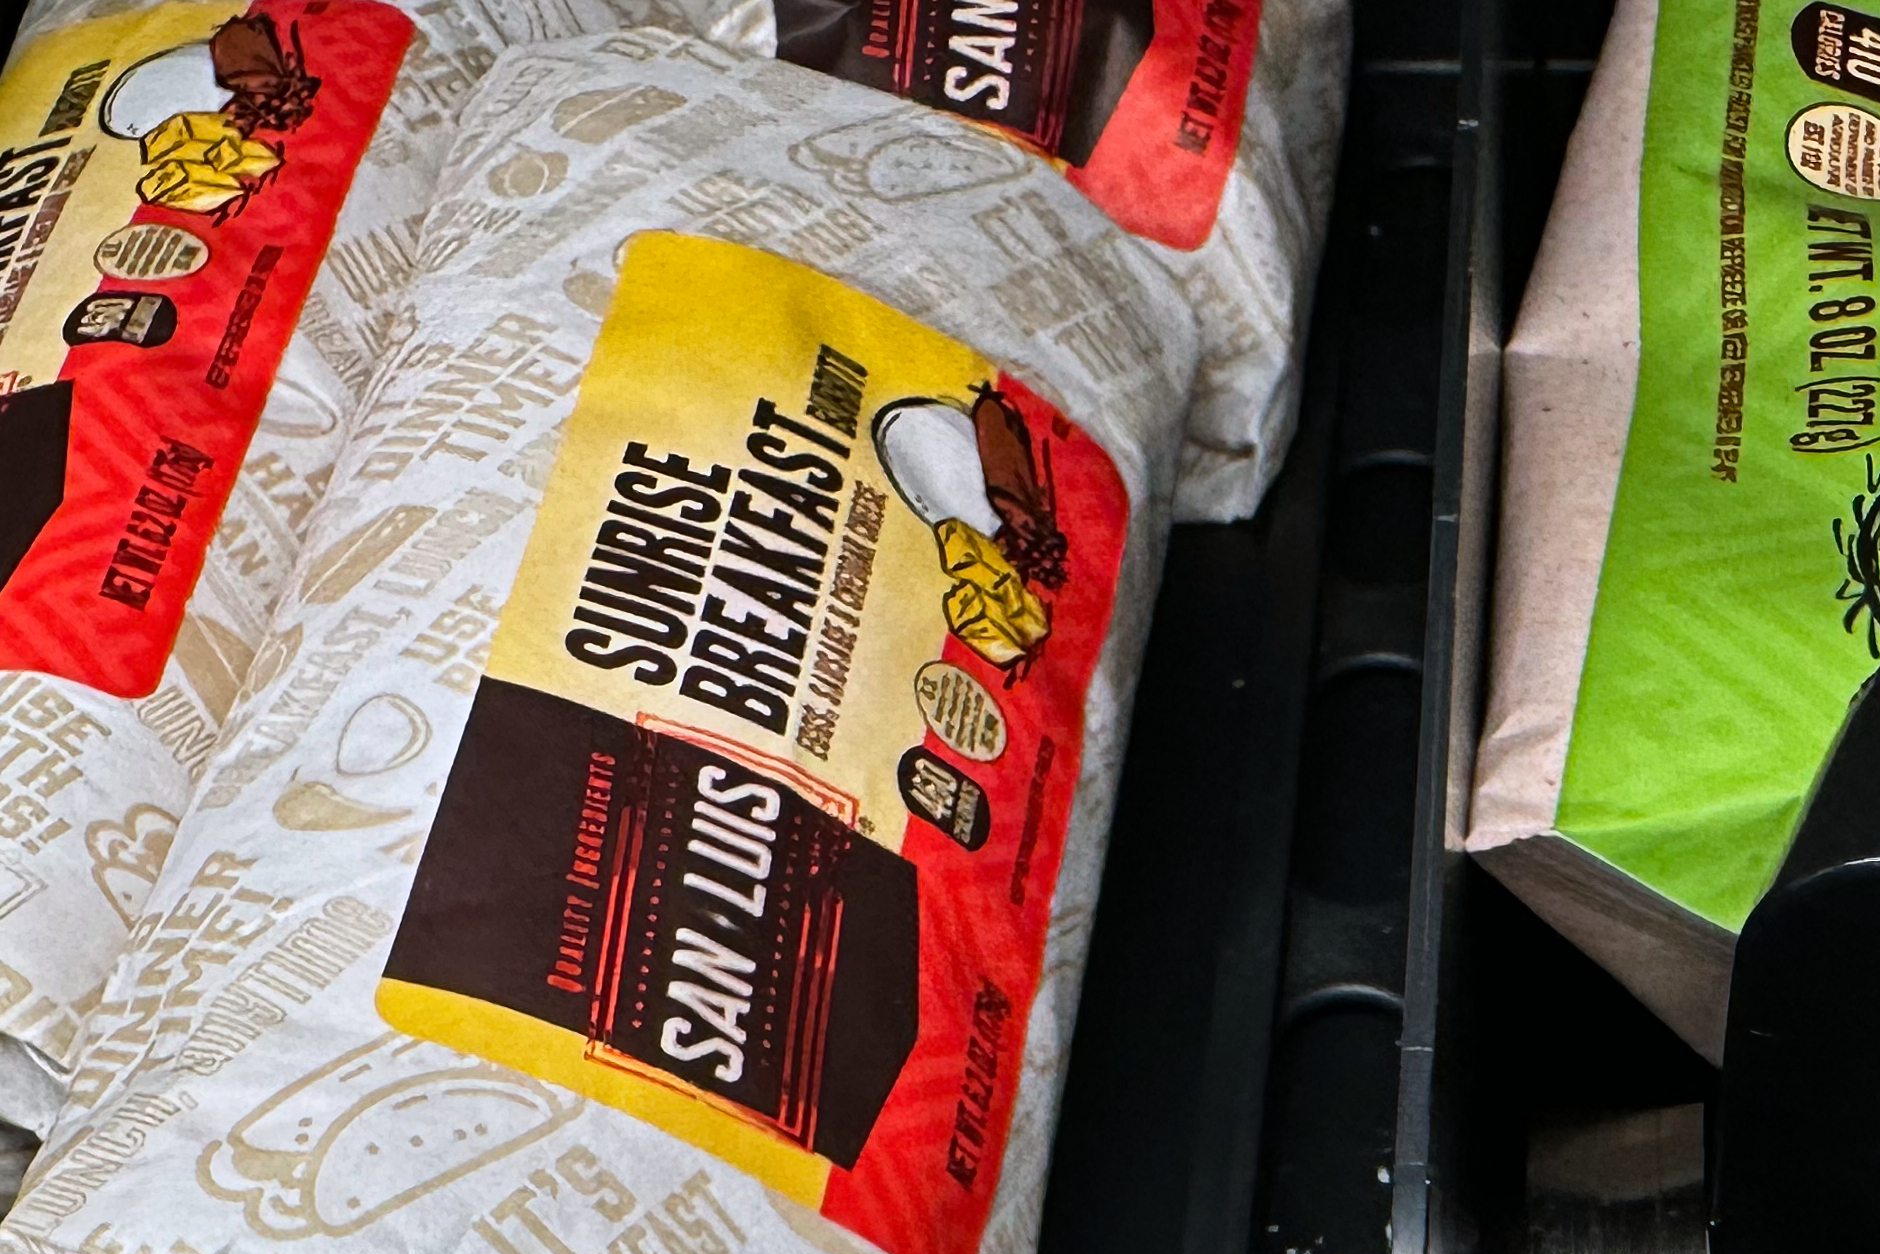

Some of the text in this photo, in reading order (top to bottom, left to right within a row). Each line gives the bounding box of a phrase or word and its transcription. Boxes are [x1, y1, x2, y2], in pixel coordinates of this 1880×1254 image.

[1808, 295, 1876, 321] 8
[1809, 325, 1877, 371] OZ
[564, 442, 732, 686] SUNRISE
[679, 397, 851, 736] BREAKFAST
[70, 851, 259, 1106] DINNER
[660, 764, 782, 1083] SAN LUIS
